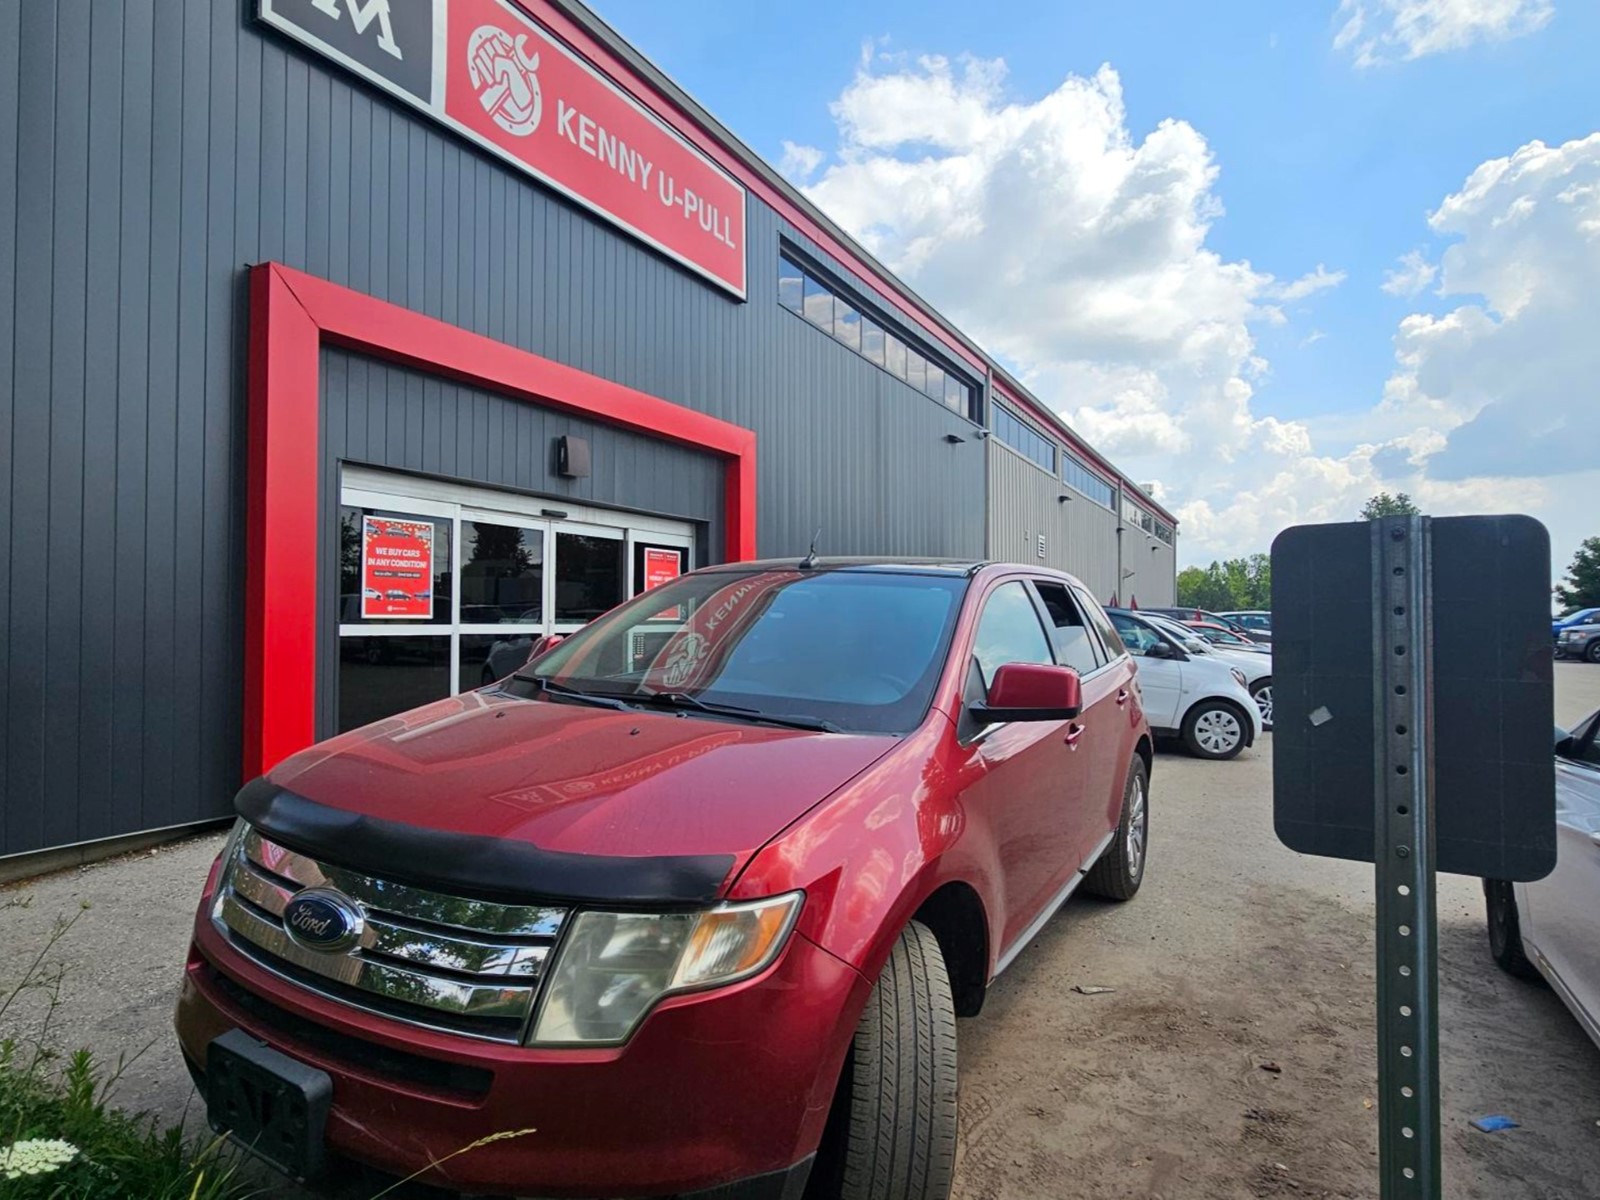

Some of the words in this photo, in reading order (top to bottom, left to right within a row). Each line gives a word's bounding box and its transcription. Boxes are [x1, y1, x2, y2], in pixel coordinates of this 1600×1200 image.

[557, 99, 653, 191] KENNY
[659, 170, 736, 250] U-PULL
[367, 557, 376, 566] IN
[376, 558, 391, 567] ANY
[375, 547, 388, 555] WE
[388, 548, 401, 557] BUY
[402, 549, 420, 558] CARS
[291, 904, 331, 936] Ford
